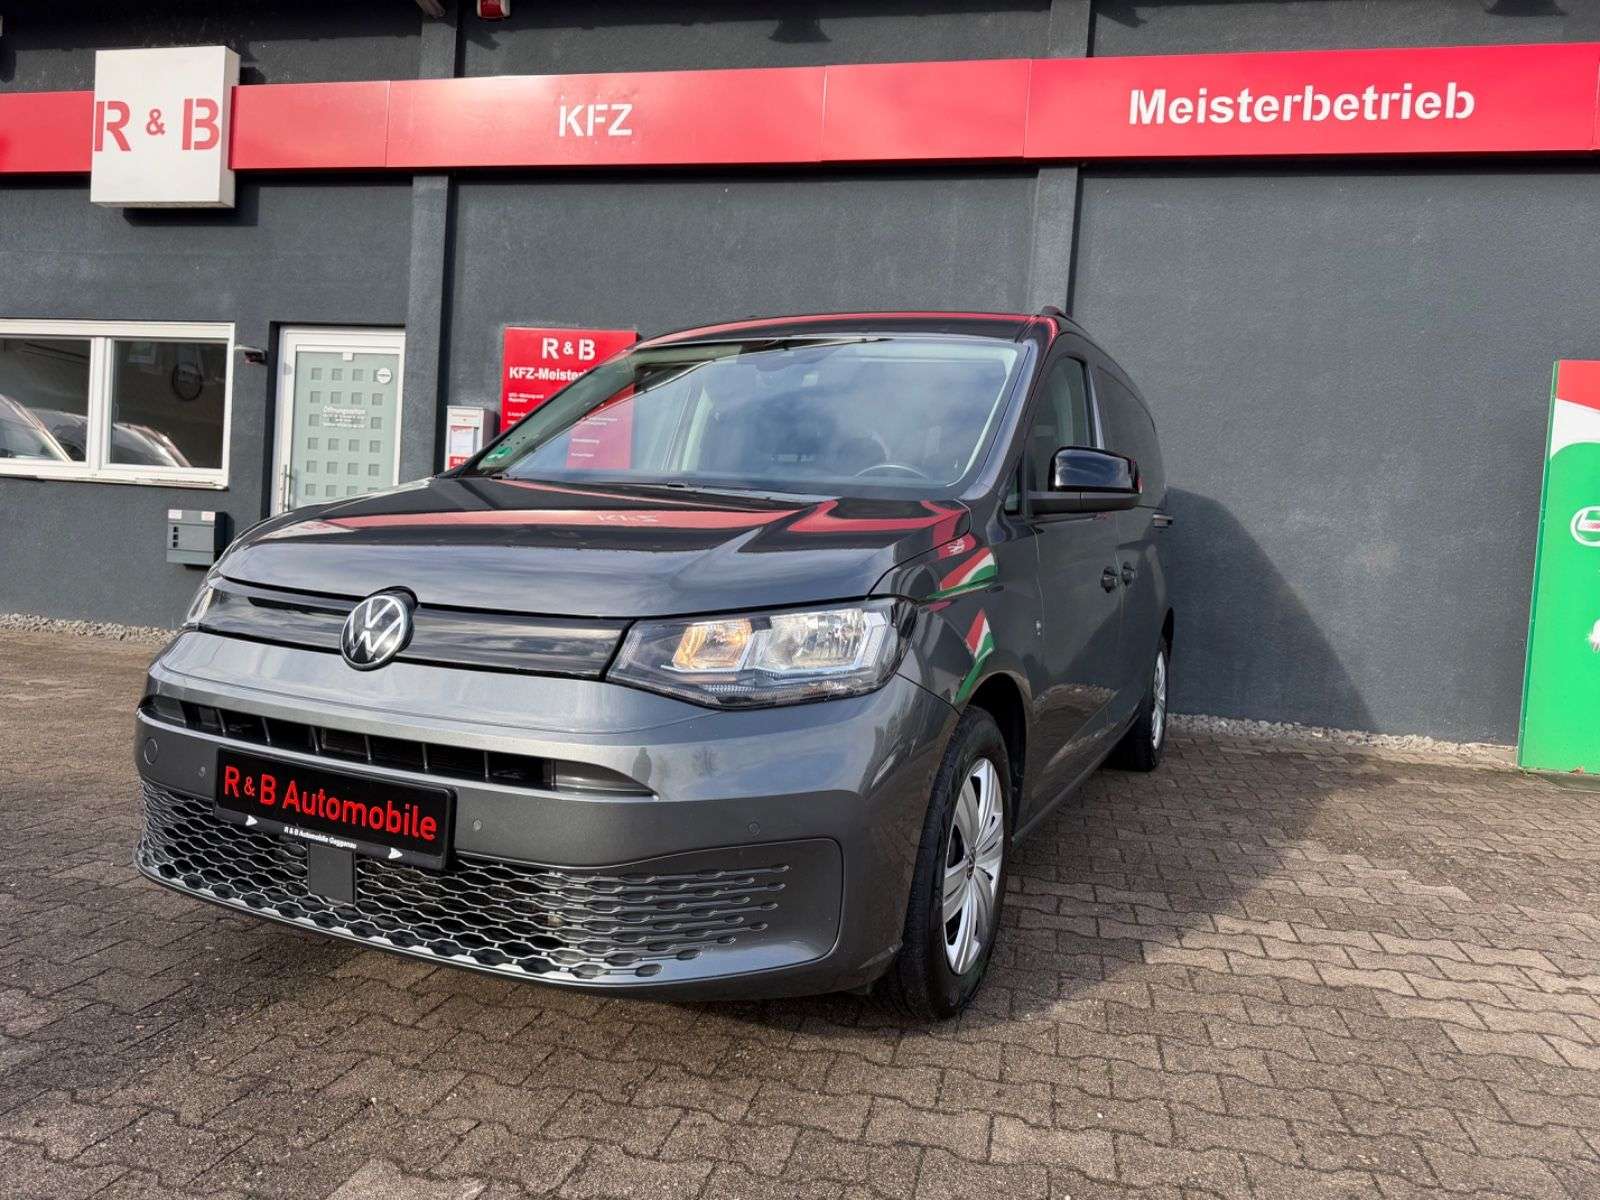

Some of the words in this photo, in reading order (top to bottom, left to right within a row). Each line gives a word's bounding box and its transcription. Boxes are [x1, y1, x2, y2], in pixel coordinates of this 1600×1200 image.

[559, 103, 633, 137] KFZ
[1129, 82, 1475, 124] Meisterbetrieb
[94, 101, 131, 151] R
[146, 109, 166, 136] &
[182, 98, 220, 150] B
[541, 337, 559, 360] R
[563, 341, 574, 355] &
[578, 338, 596, 361] B
[224, 766, 240, 797] R
[244, 776, 256, 796] &
[260, 774, 277, 805] B
[282, 780, 437, 841] Automobile
